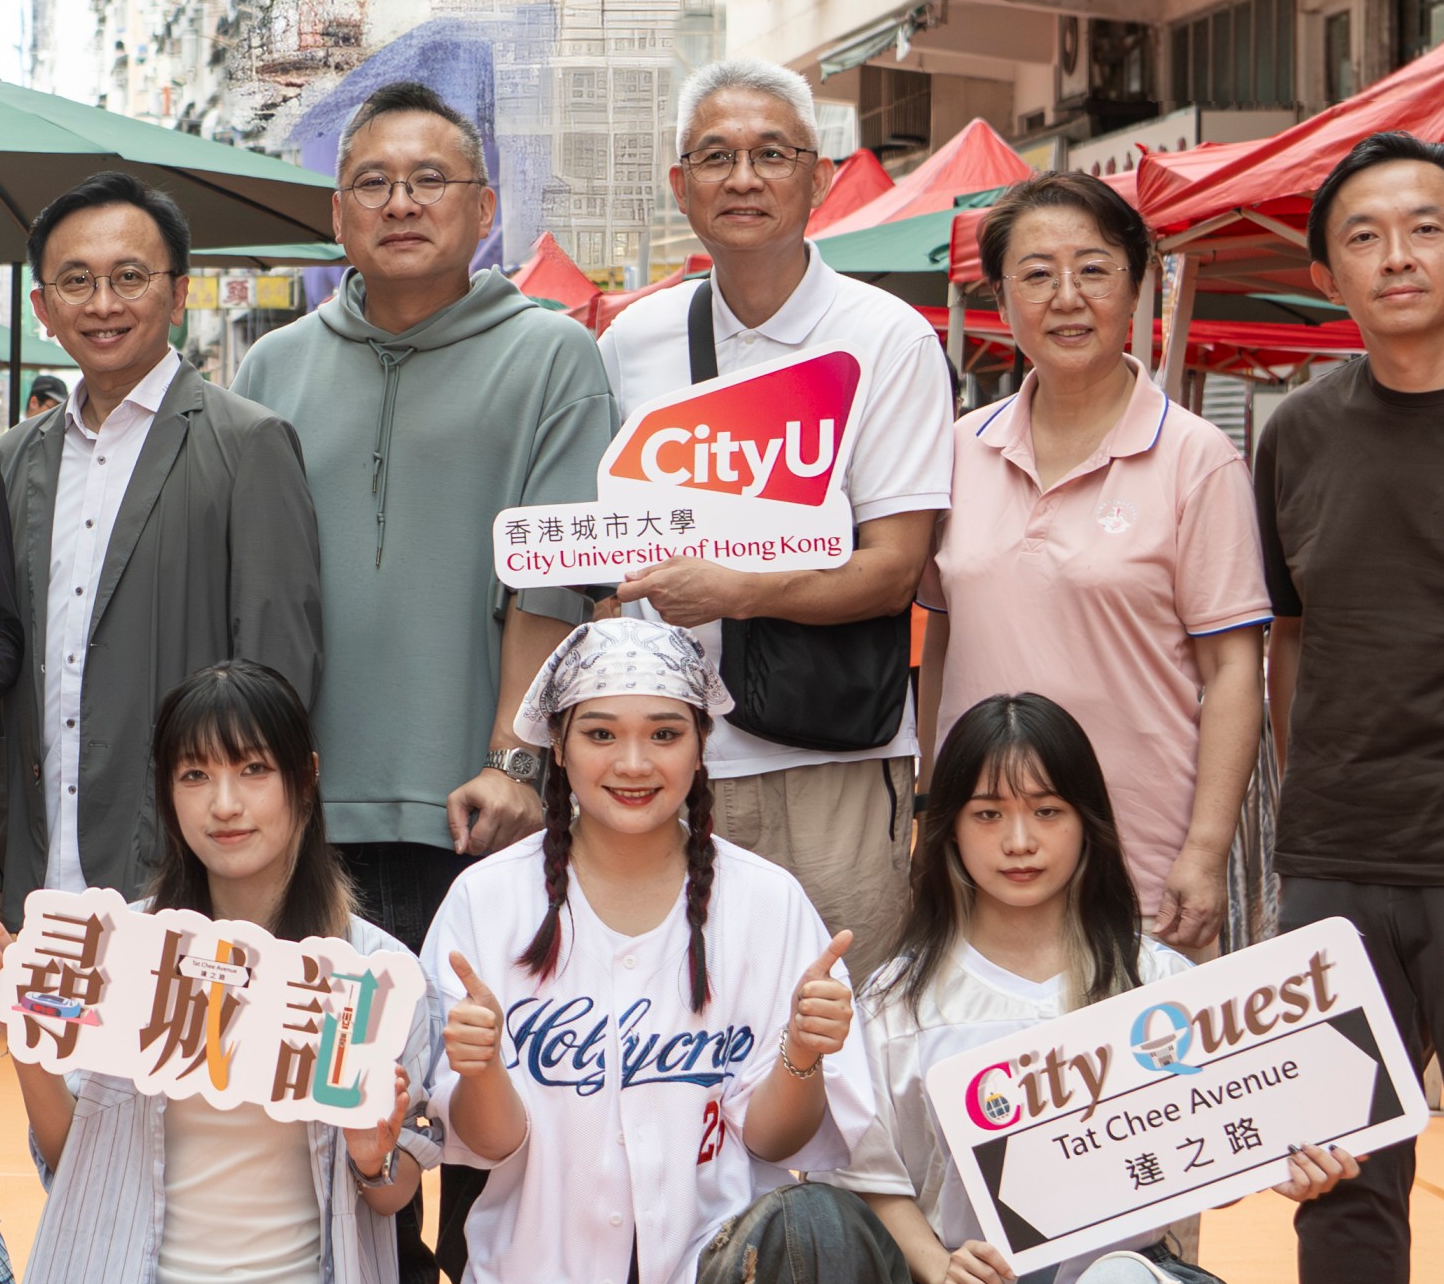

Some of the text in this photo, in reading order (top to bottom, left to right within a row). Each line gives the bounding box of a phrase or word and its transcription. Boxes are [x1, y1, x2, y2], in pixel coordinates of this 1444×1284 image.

[640, 417, 835, 498] CityU
[505, 508, 697, 547] 香港城市大學
[506, 534, 842, 575] City University of Hong Kong
[16, 912, 381, 1109] 尋城記
[965, 949, 1338, 1131] City Quest
[1052, 1059, 1300, 1161] Tat Chee Avenue
[1123, 1117, 1264, 1191] 達之路
